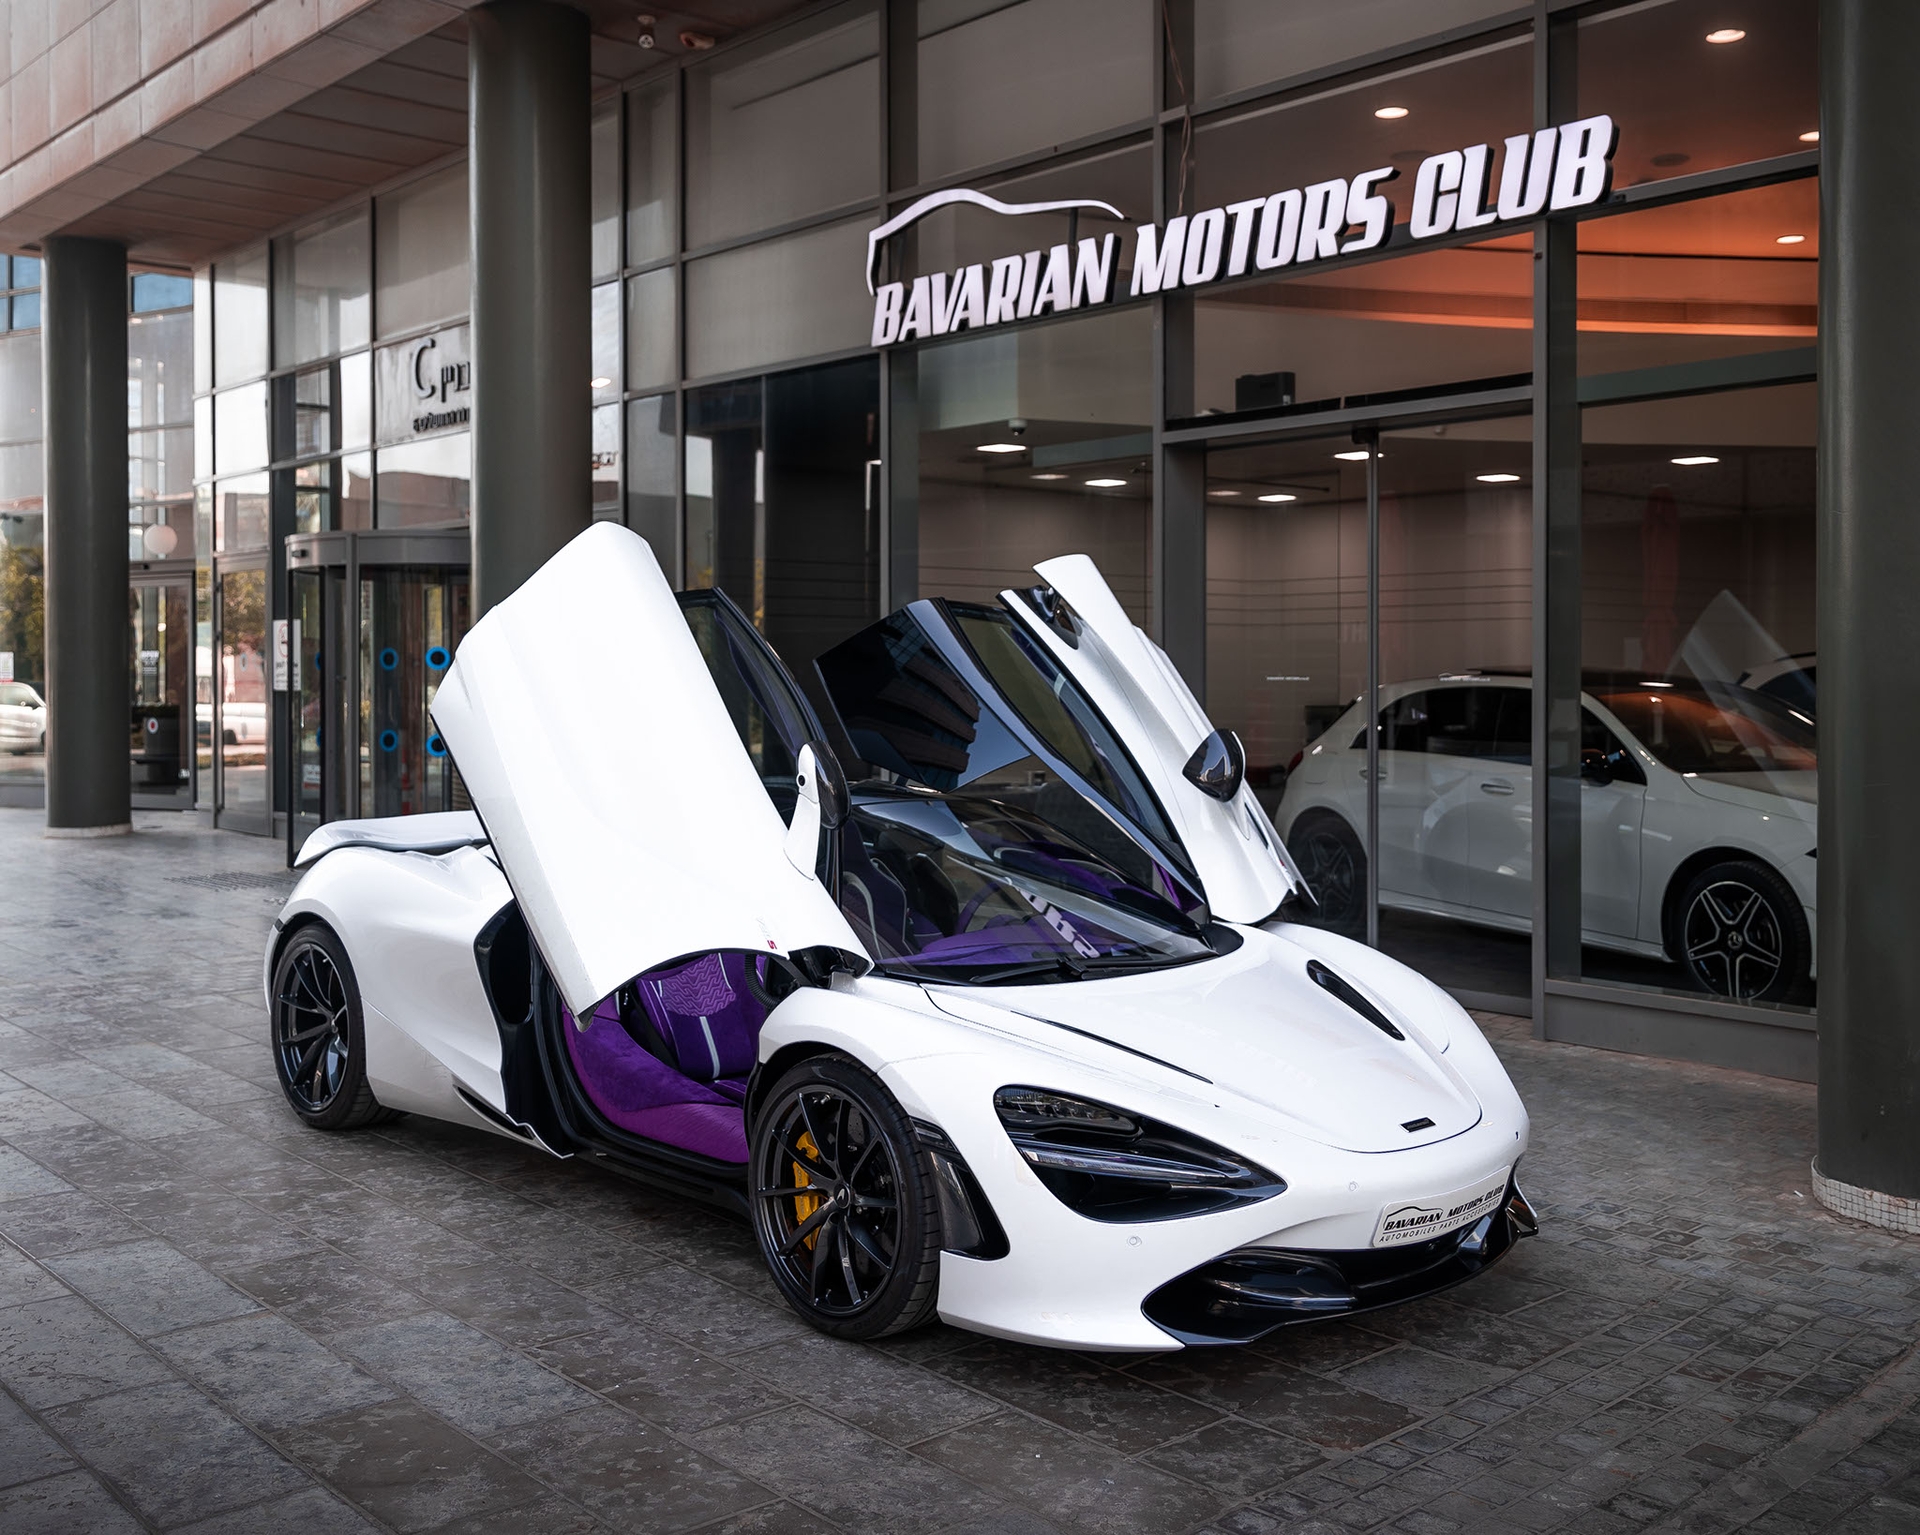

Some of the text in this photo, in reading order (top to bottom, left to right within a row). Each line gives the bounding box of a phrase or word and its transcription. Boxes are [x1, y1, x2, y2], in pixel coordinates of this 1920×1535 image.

[871, 114, 1618, 348] BAVARIAN MOTORS CLUB
[1379, 1226, 1436, 1242] AUTOMOBILES
[1439, 1218, 1460, 1231] PARTS
[1384, 1184, 1505, 1231] BAVARIAN MOTORS CLUB
